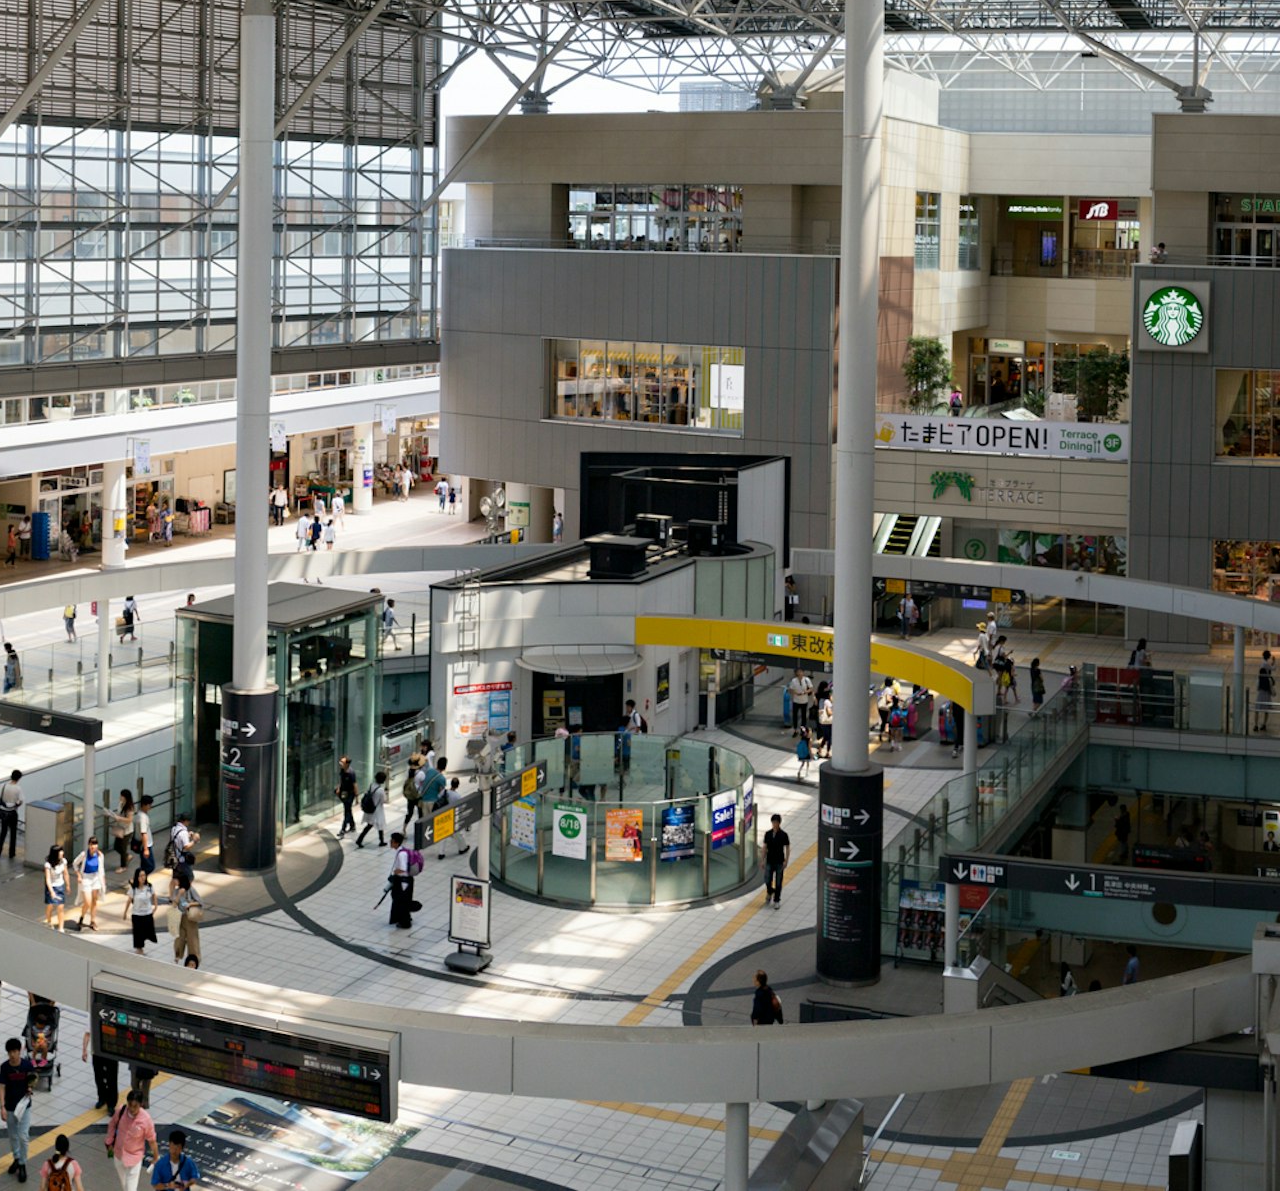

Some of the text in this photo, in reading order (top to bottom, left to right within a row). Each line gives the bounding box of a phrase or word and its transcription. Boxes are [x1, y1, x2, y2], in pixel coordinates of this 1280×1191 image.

[1086, 202, 1109, 219] JTB
[1060, 428, 1099, 440] Terrace
[1059, 440, 1093, 453] Dining
[1105, 437, 1120, 449] 3F
[979, 488, 1044, 505] TERRACE
[230, 747, 241, 767] 2
[714, 807, 733, 824] Sale!
[559, 817, 580, 830] 8/18
[828, 837, 834, 858] 1
[1089, 873, 1096, 891] 1
[109, 1009, 117, 1023] 2
[362, 1065, 368, 1079] 1
